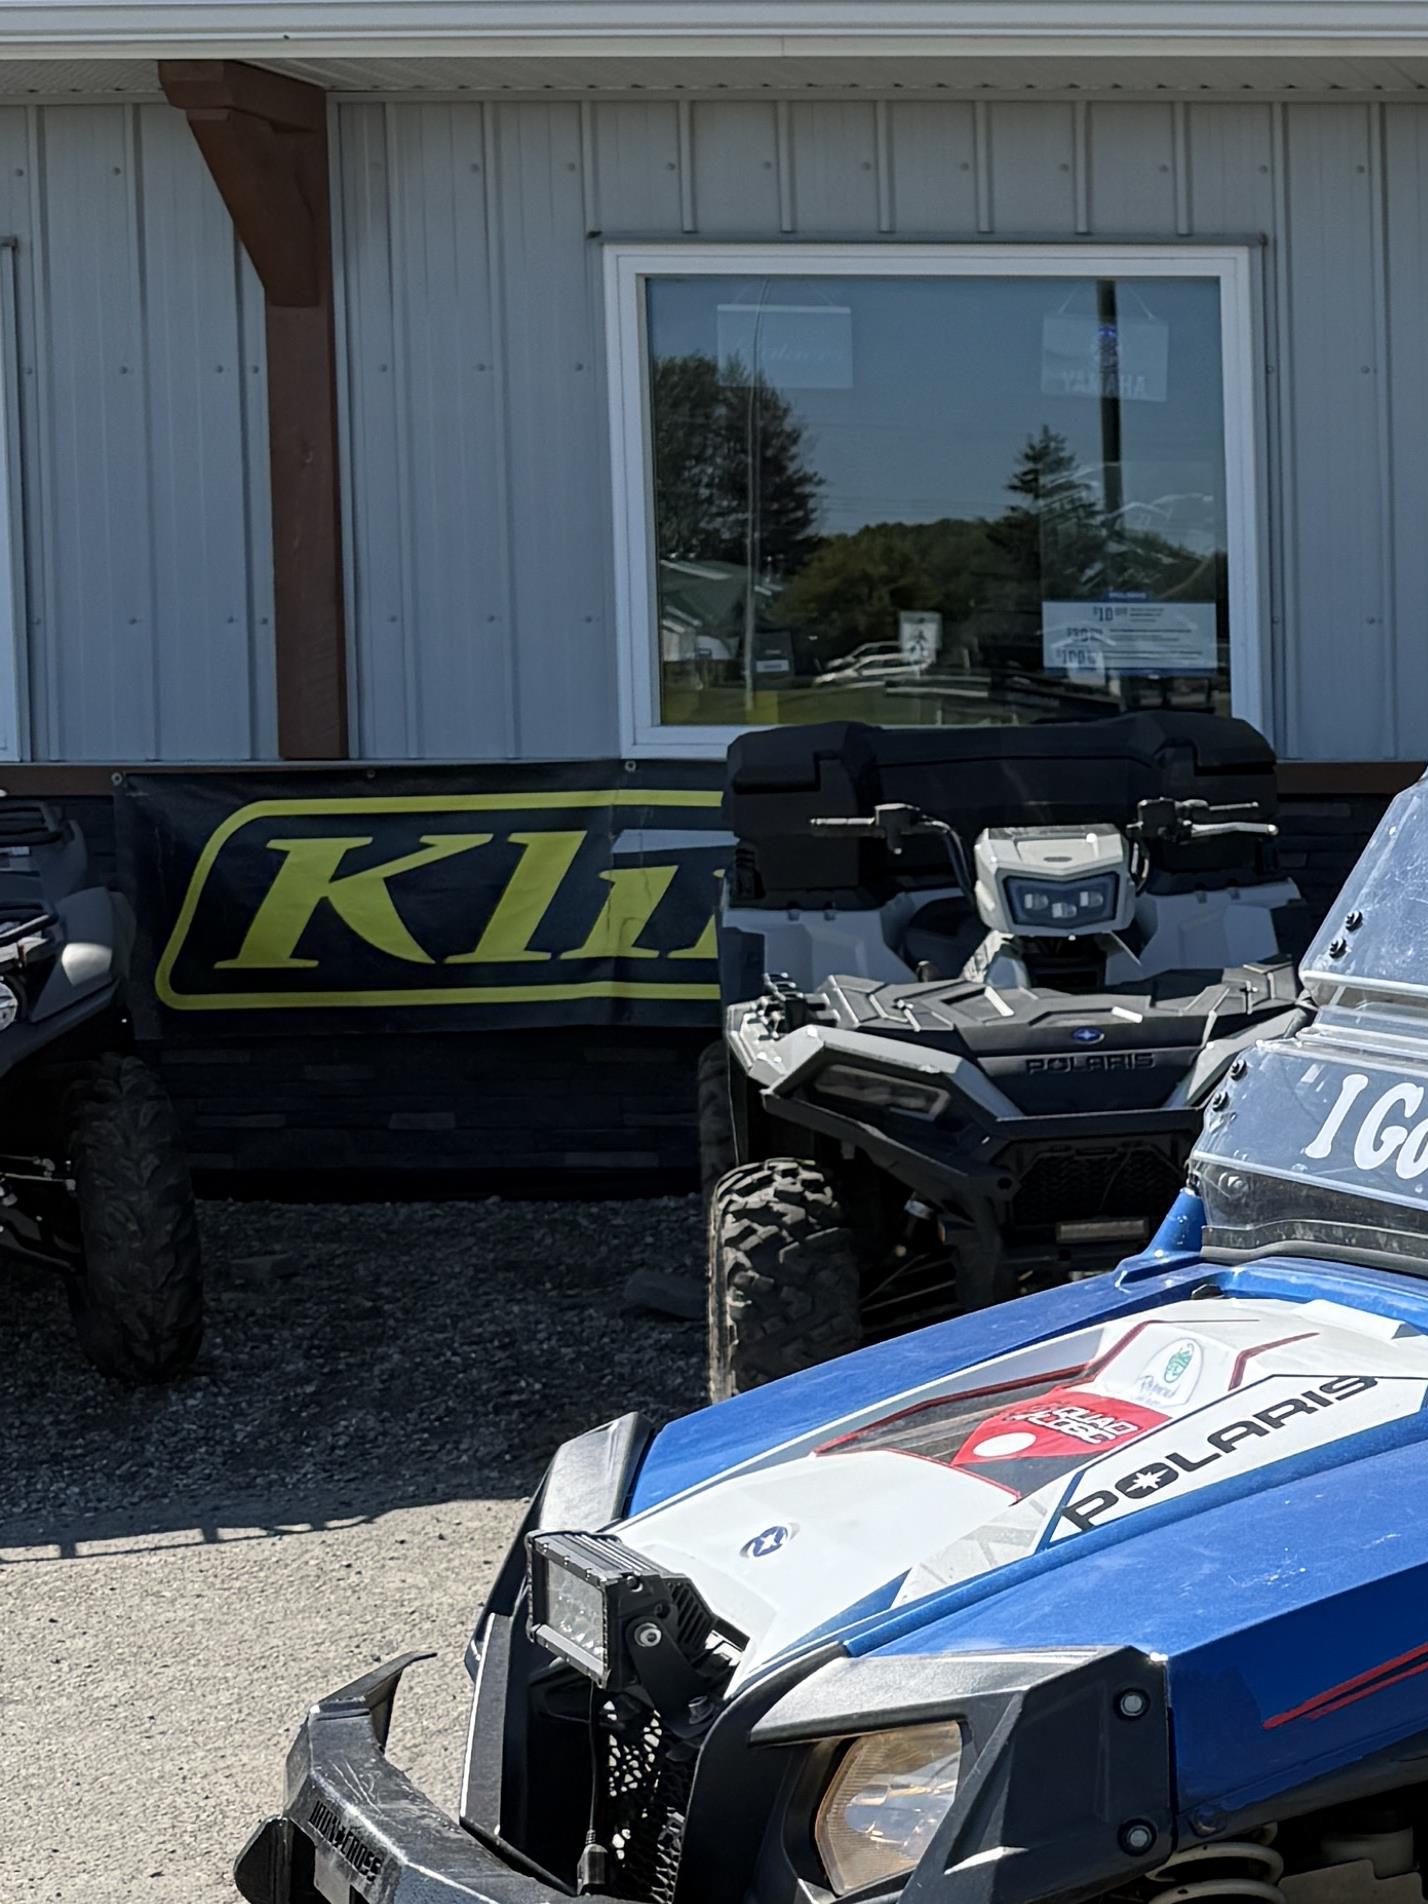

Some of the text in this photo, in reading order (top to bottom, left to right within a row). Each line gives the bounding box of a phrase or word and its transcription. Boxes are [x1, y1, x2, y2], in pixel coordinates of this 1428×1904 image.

[1025, 1053, 1157, 1076] POLARIS
[1305, 1073, 1369, 1160] I
[1056, 1375, 1383, 1533] POLARIS
